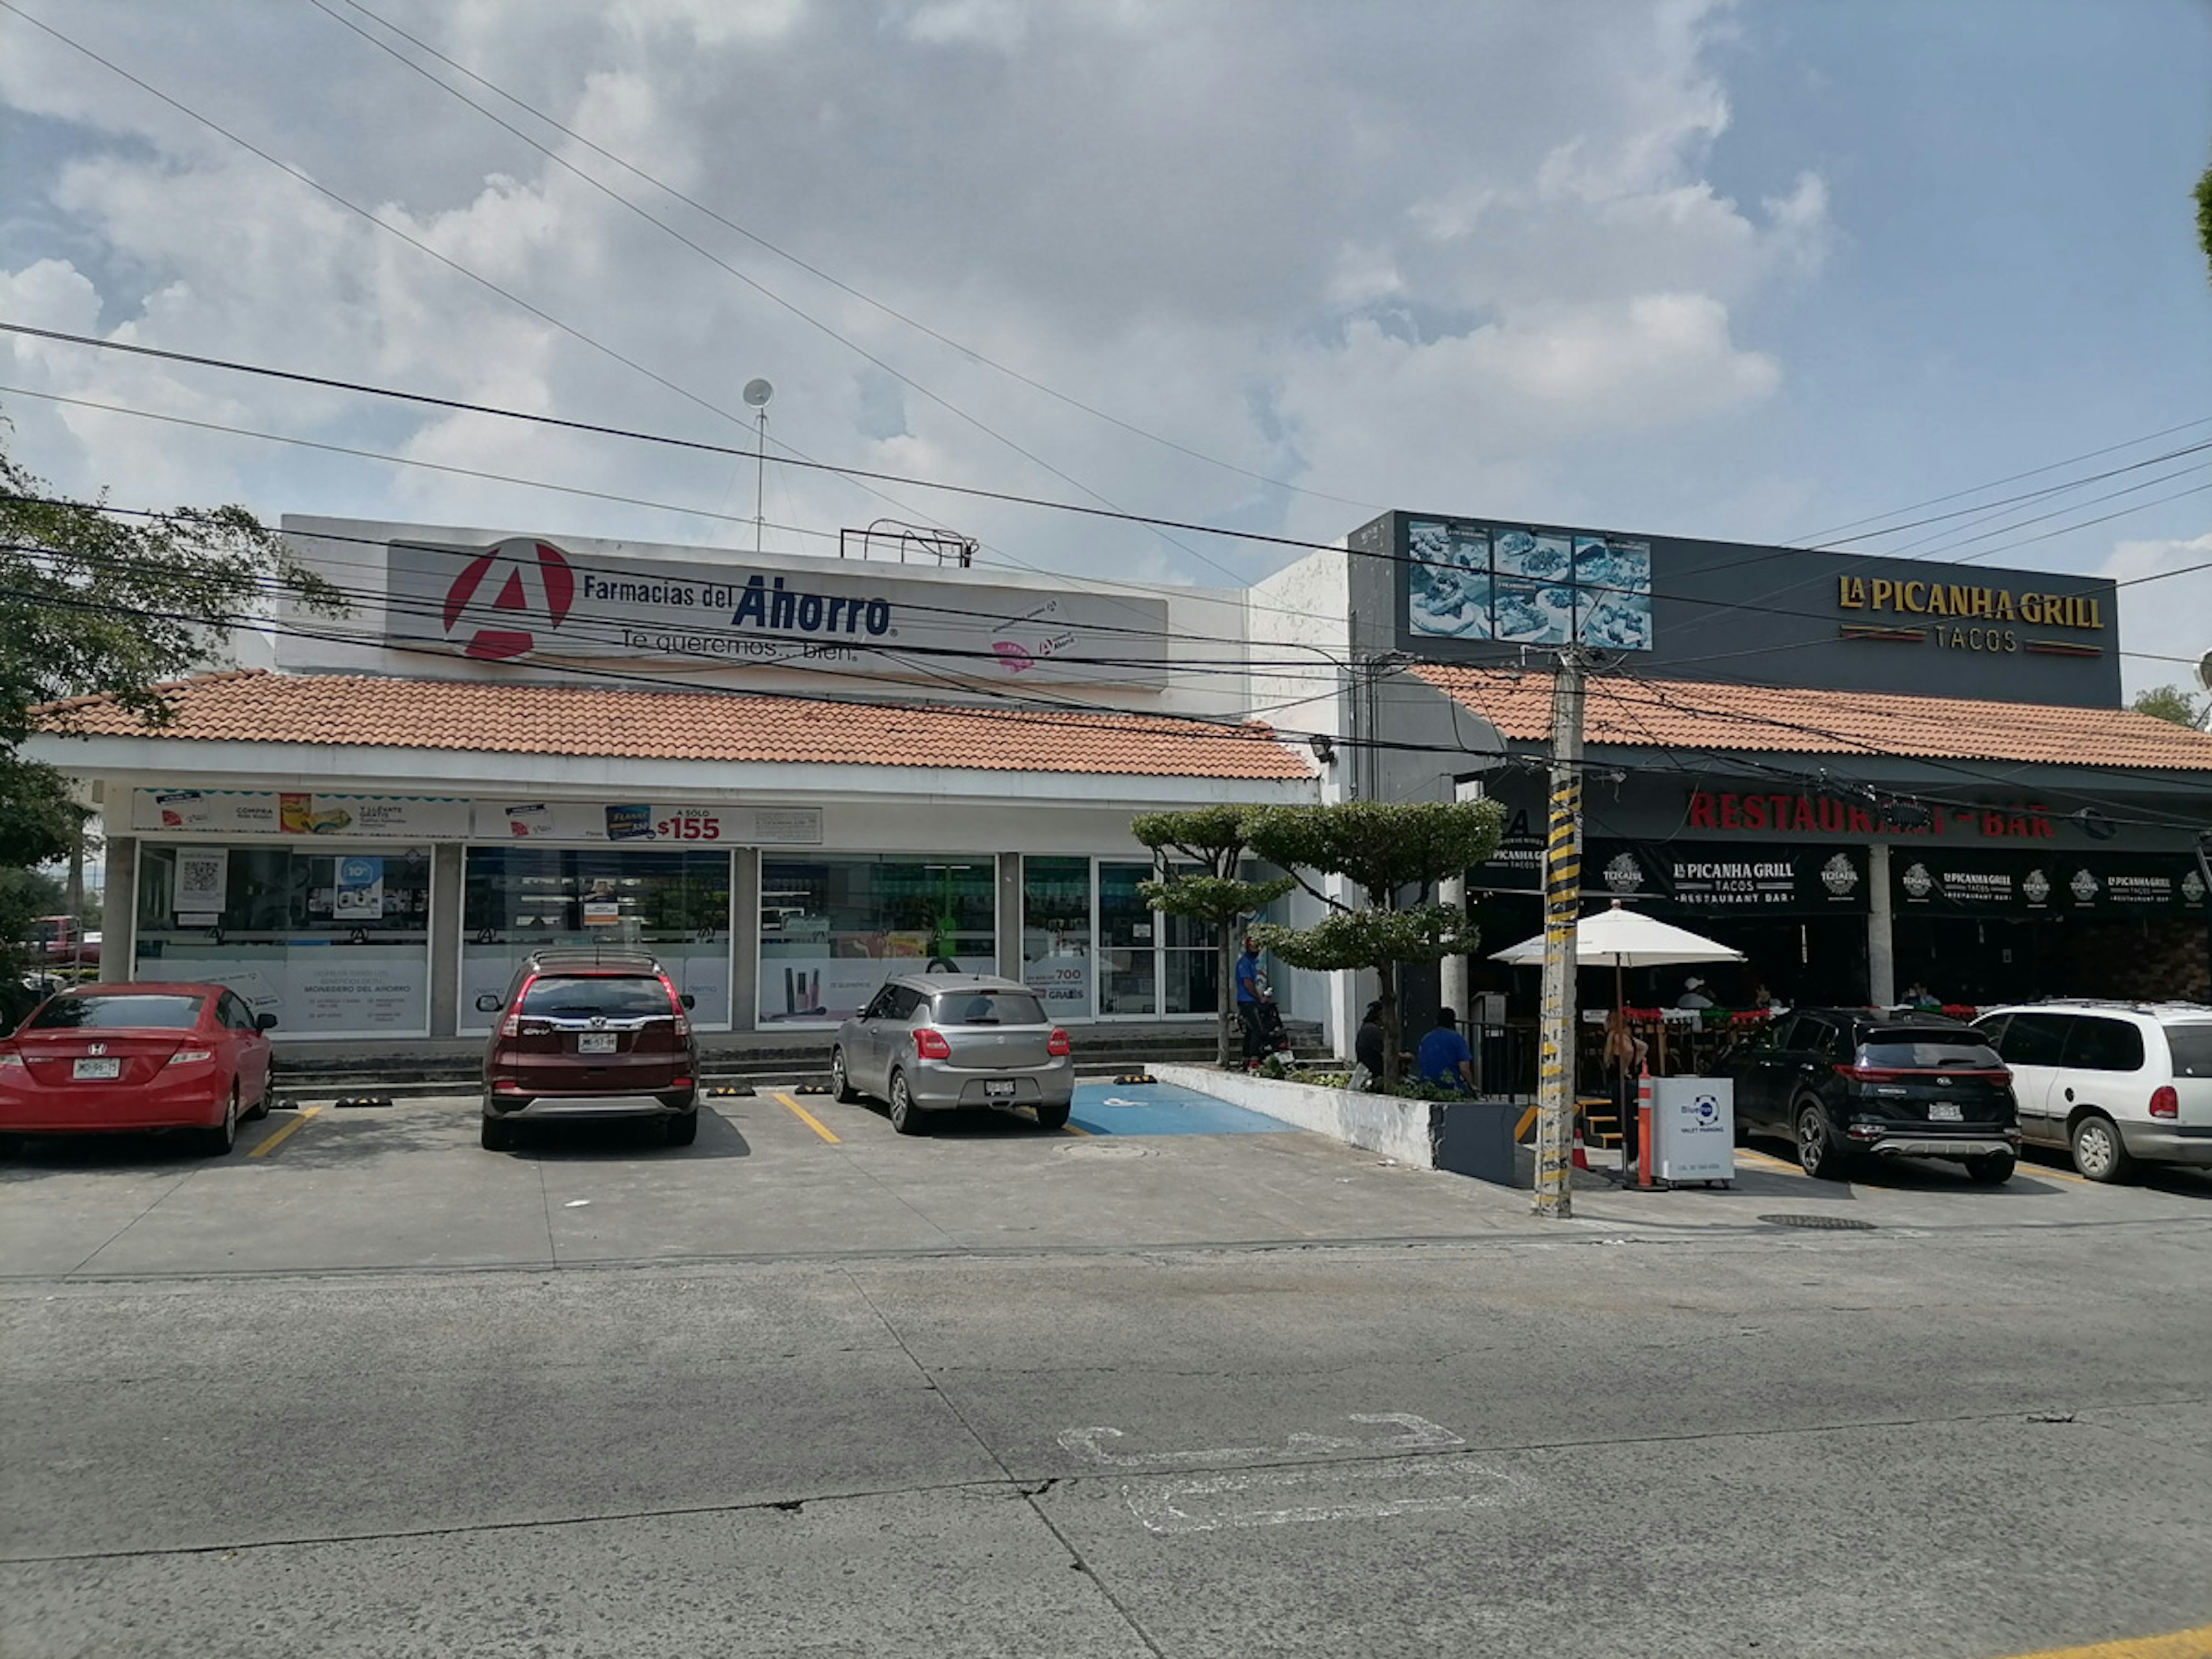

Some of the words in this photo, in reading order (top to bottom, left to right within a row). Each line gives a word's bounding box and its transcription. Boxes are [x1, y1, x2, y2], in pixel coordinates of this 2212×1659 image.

[584, 574, 694, 605] Farmacias
[702, 583, 732, 608] del
[1839, 575, 1865, 608] LA
[1872, 578, 2016, 622] PICANHA
[2019, 592, 2104, 628] GRILL
[622, 628, 646, 648] Te
[1936, 624, 2017, 653] TACOS
[1690, 793, 1944, 836] RESTAURT
[657, 817, 719, 840] $155
[1687, 863, 1753, 879] PICANHA
[1753, 862, 1795, 877] GRILL
[1715, 880, 1755, 892] TACOS
[1056, 969, 1081, 979] 700
